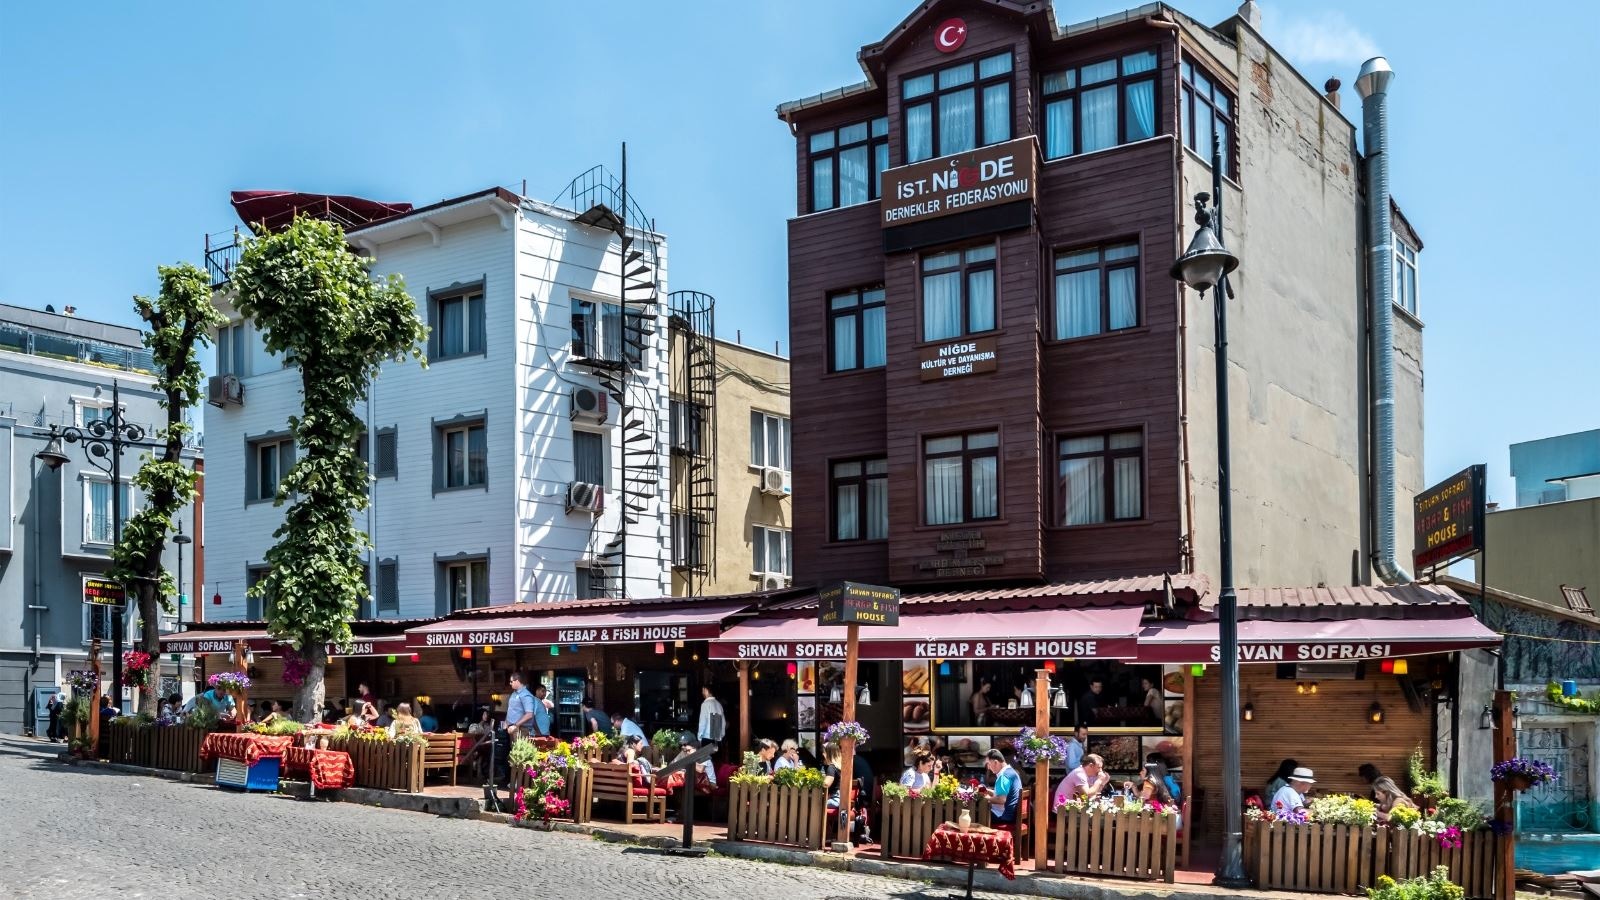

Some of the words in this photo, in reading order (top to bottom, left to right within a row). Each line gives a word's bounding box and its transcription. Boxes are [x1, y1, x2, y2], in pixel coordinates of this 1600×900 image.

[886, 200, 940, 222] DERNEKLER
[946, 179, 1028, 209] FEDERASYONU
[940, 343, 977, 356] NİĞDE
[948, 357, 957, 365] VE
[1428, 523, 1457, 547] HOUSE
[856, 611, 886, 622] HOUSE
[468, 631, 514, 644] SOFRASI
[558, 629, 597, 642] KEBAP
[600, 629, 609, 640] &
[643, 626, 687, 639] HOUSE
[915, 643, 970, 656] KEBAP
[975, 643, 986, 656] &
[1035, 641, 1097, 656] HOUSE
[1297, 644, 1391, 659] SOFRASI
